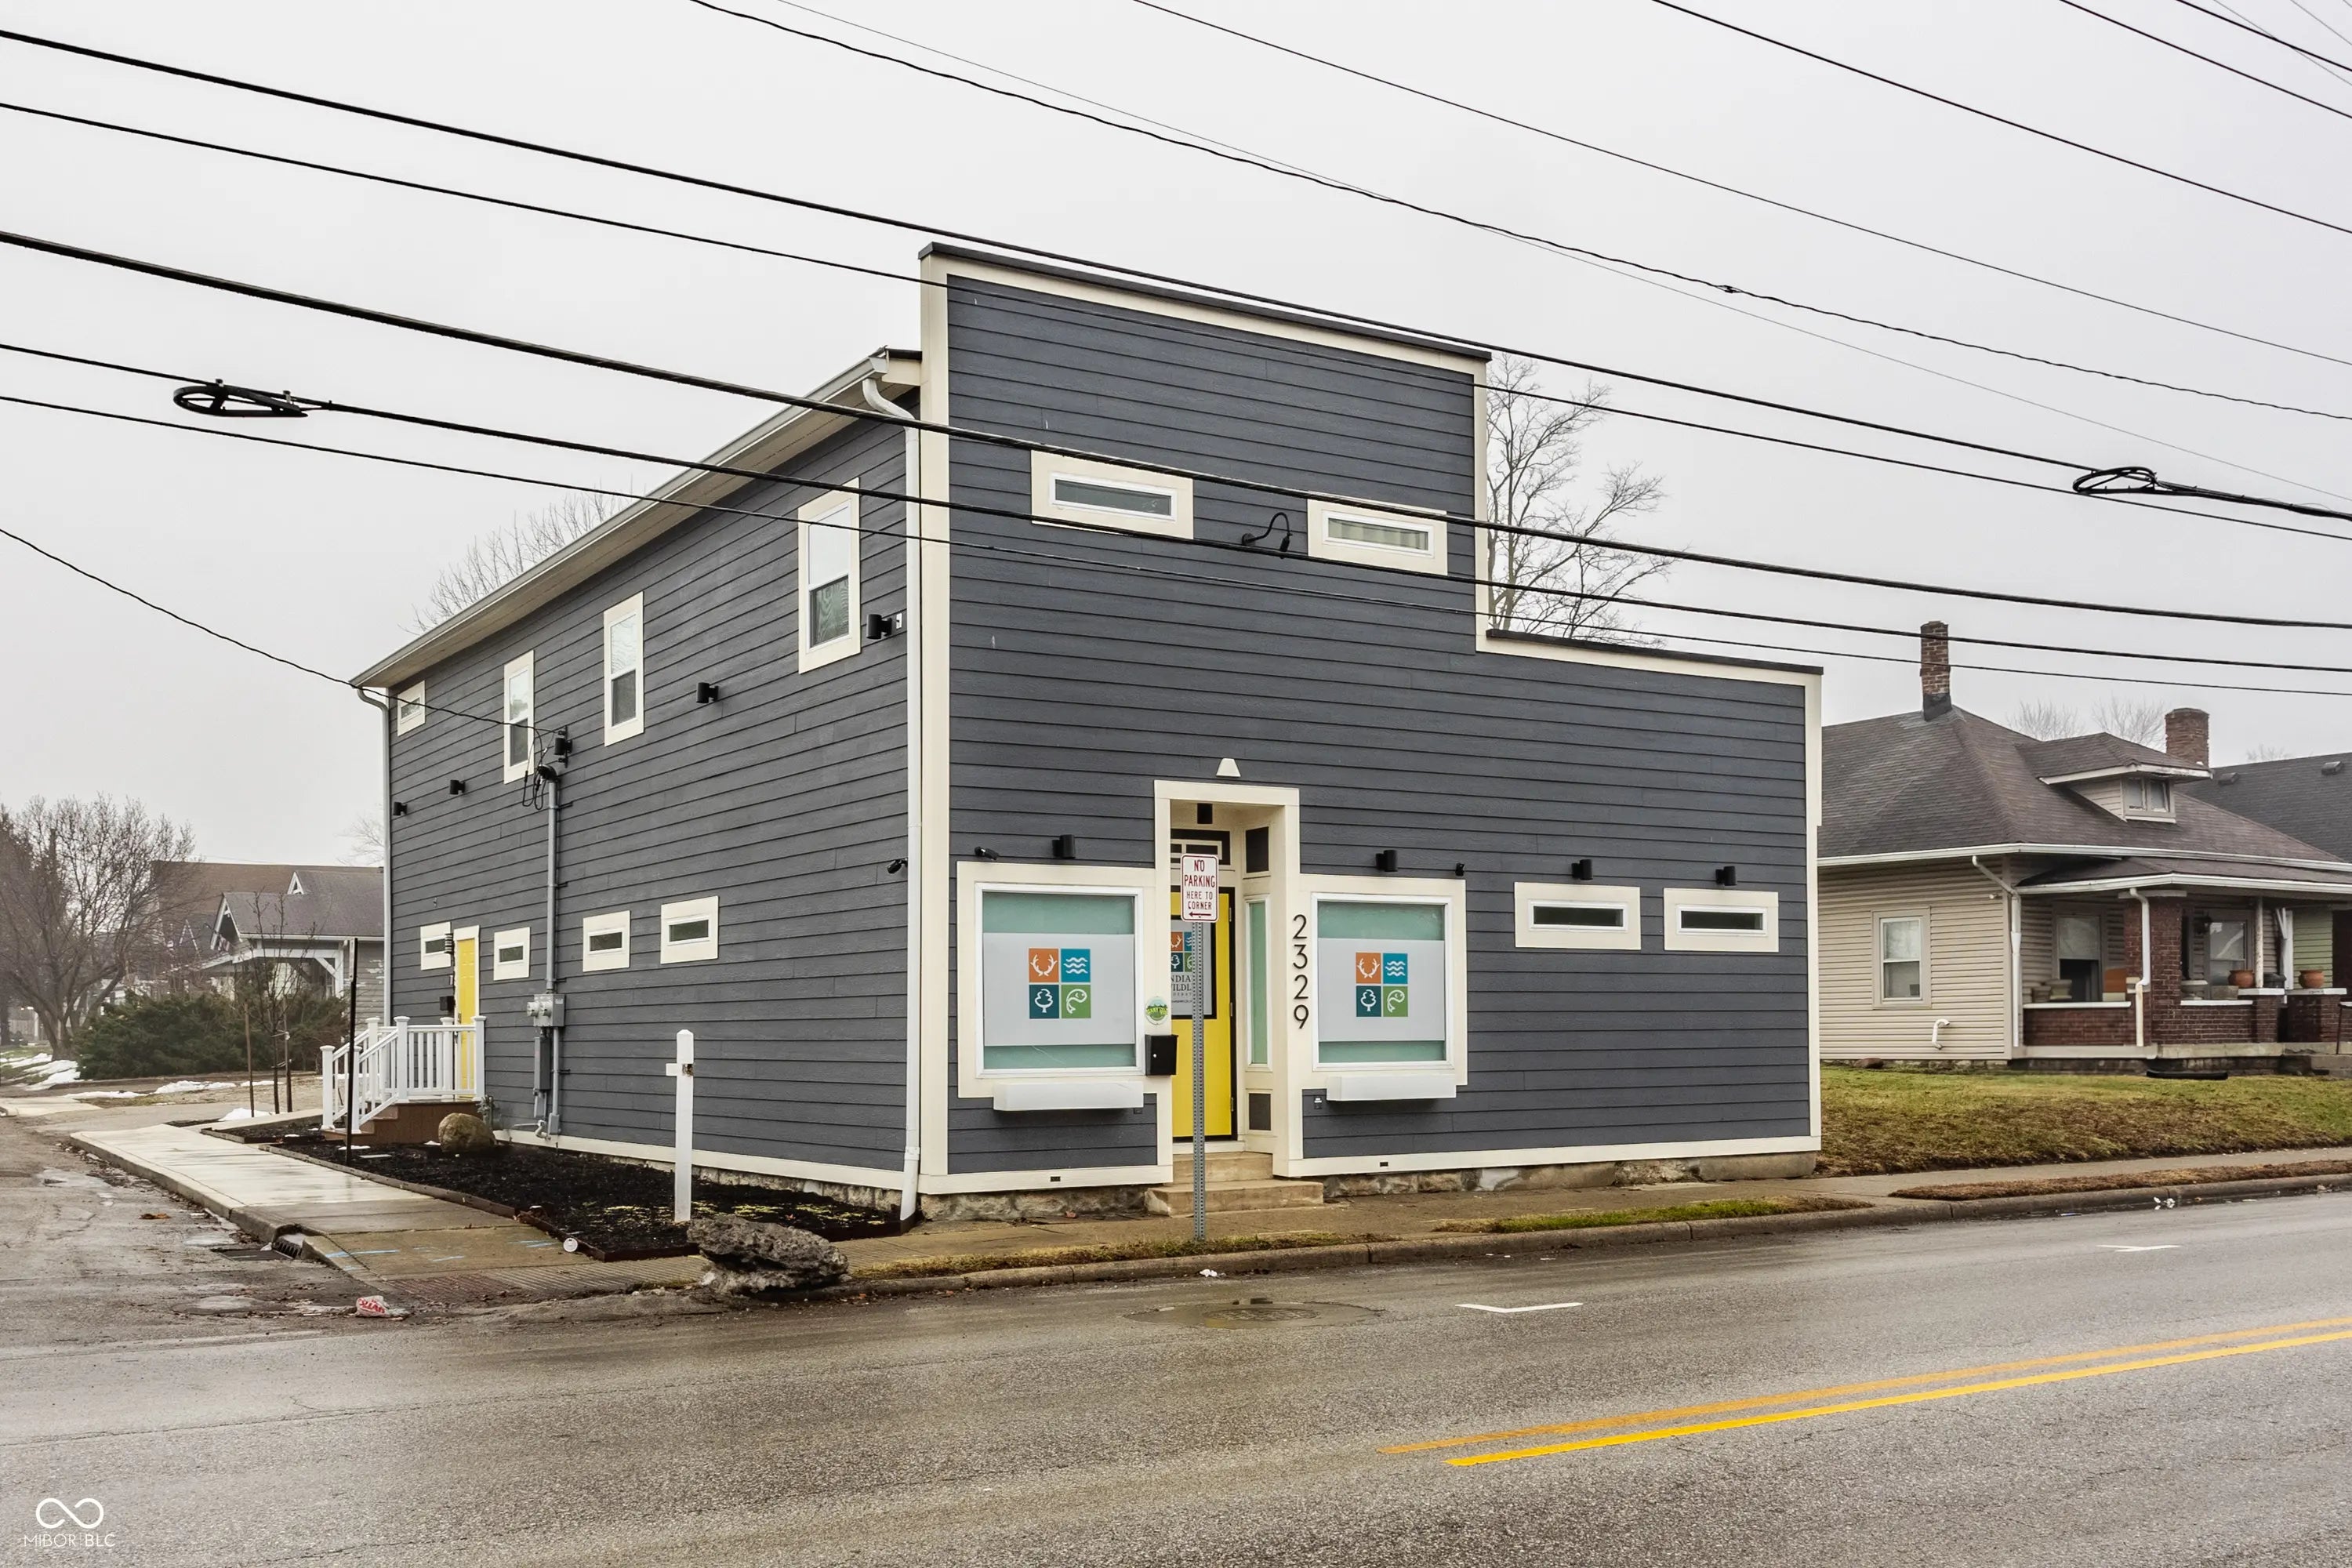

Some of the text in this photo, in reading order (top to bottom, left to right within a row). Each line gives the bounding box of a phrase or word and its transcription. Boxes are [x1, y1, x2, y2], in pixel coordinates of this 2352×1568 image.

[1194, 859, 1205, 872] NO
[1185, 874, 1215, 887] PARKING
[1186, 891, 1213, 900] HERE TO
[1188, 901, 1212, 909] CORNER
[1293, 914, 1309, 1029] 2329
[1171, 983, 1192, 992] ILDL
